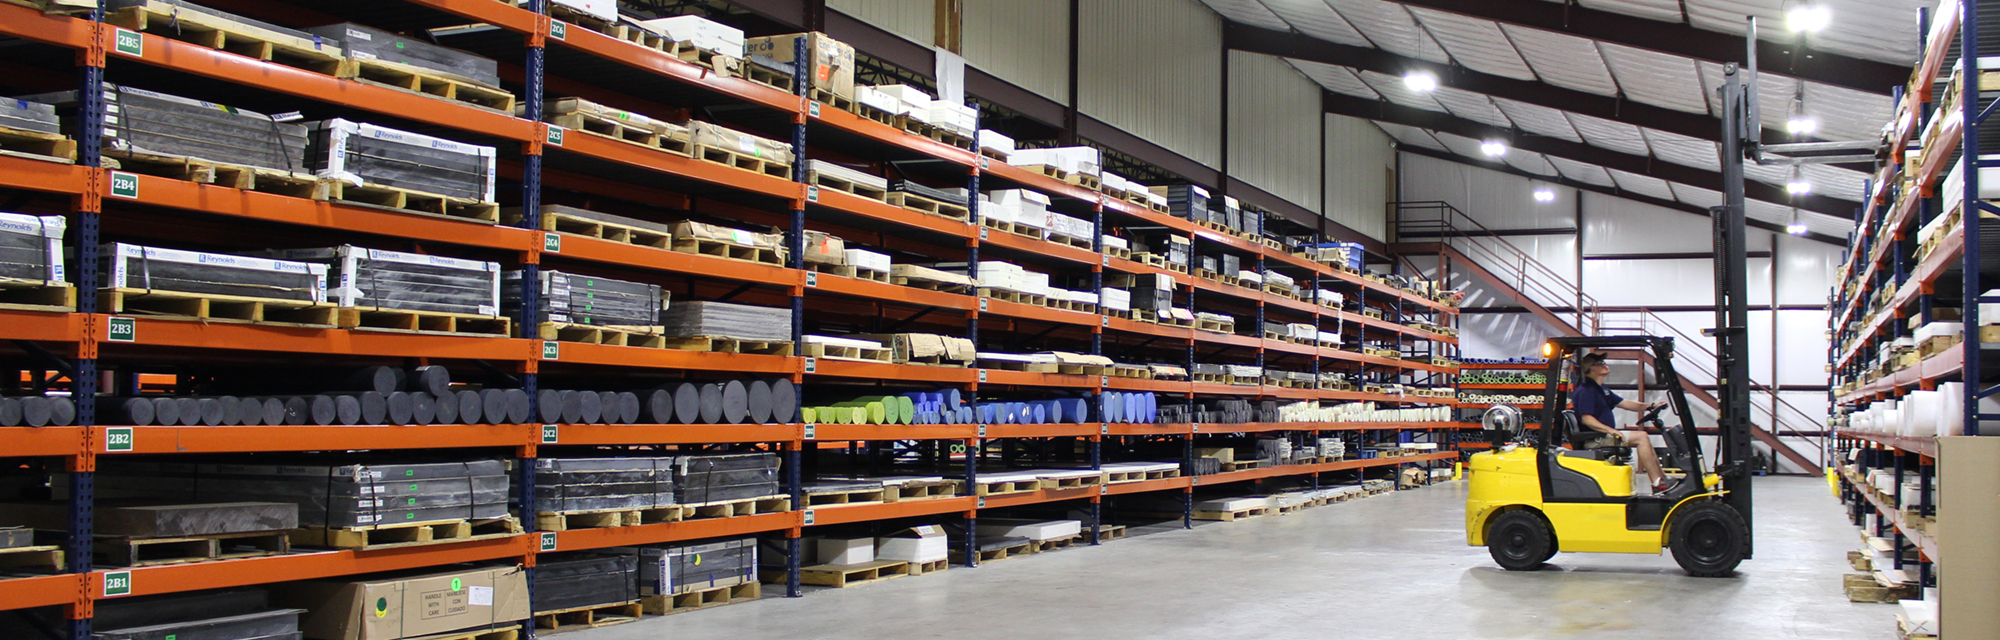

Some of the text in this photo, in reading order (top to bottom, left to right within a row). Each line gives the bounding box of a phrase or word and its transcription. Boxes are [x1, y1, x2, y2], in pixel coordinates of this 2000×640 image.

[552, 25, 564, 35] 2C6
[118, 35, 139, 49] 2B5
[549, 130, 561, 140] 2C5
[114, 178, 135, 191] 2B4
[546, 238, 558, 247] 2C4
[207, 255, 235, 264] Reynolds
[282, 262, 308, 271] Reynold
[111, 323, 131, 334] 2B3
[544, 346, 556, 354] 2C3
[544, 429, 556, 438] 2C2
[109, 434, 129, 444] 2B2
[543, 537, 554, 546] 2C1
[107, 577, 127, 589] 2B1
